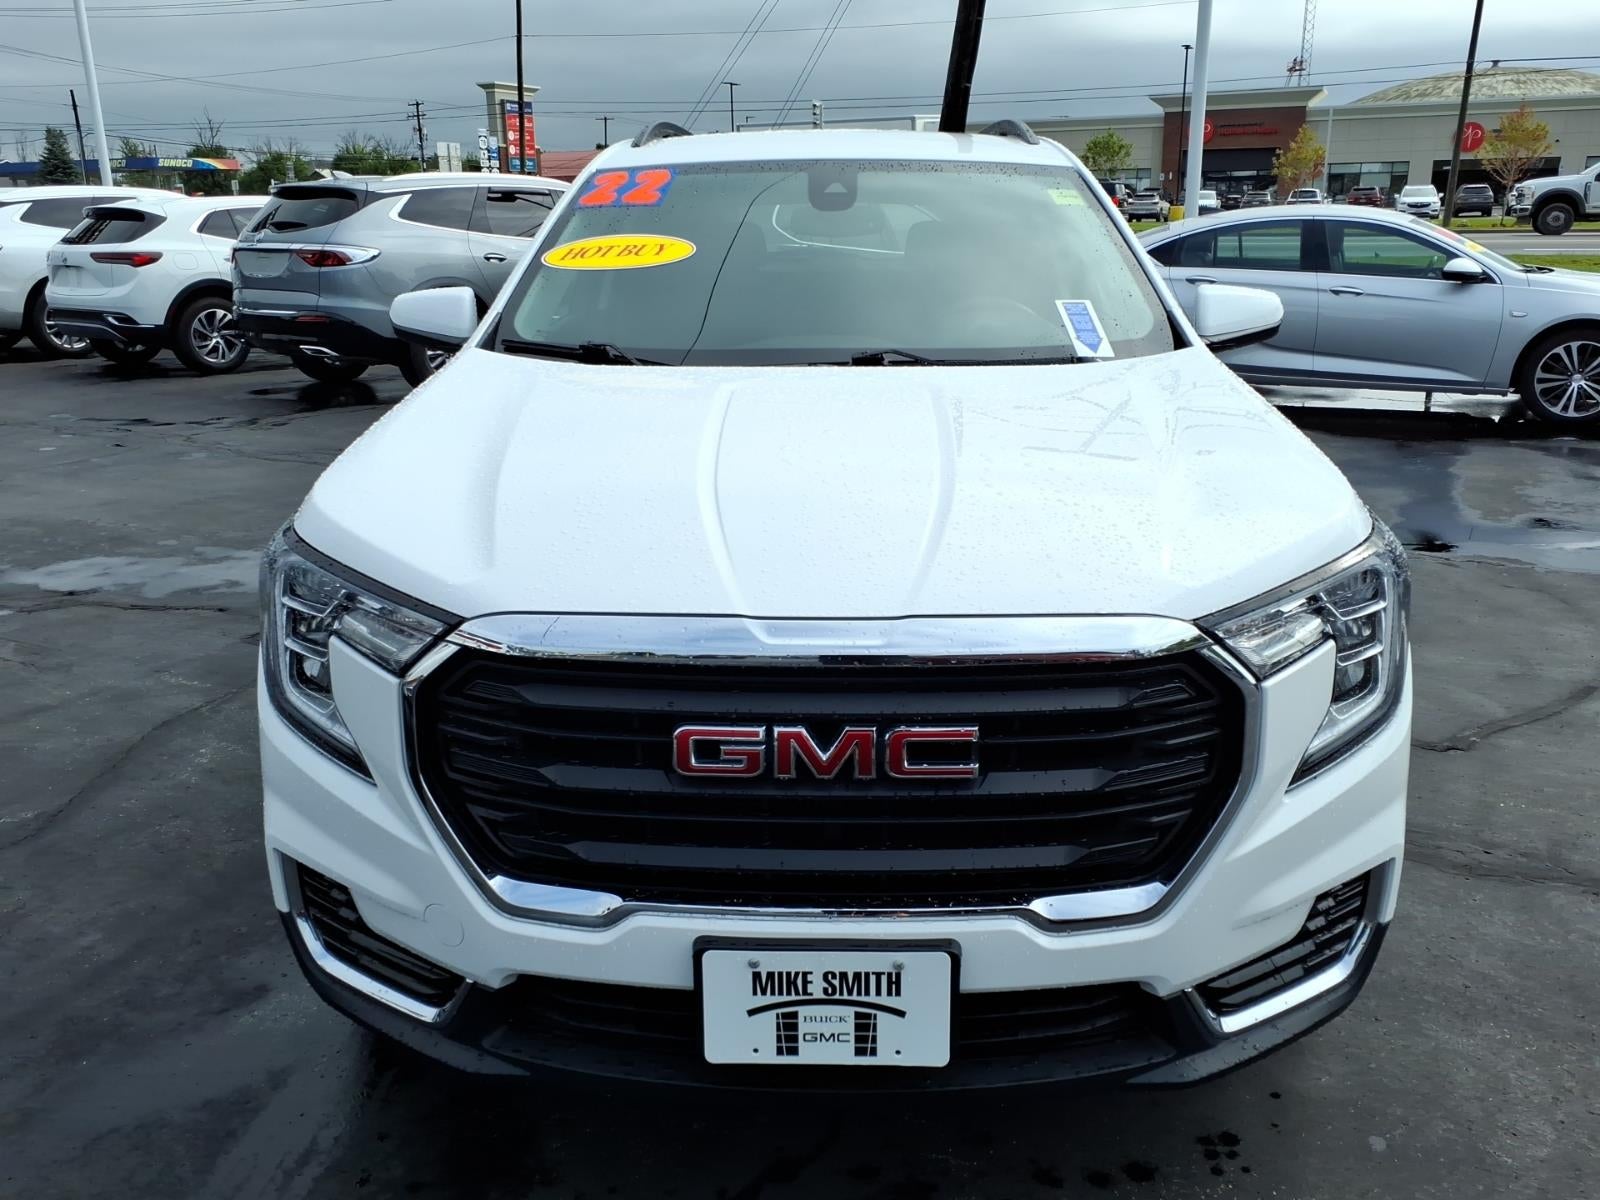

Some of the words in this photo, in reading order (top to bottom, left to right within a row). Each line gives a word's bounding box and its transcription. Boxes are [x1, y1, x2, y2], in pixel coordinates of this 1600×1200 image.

[158, 158, 193, 167] SUNOCO
[579, 169, 672, 206] 22
[560, 244, 618, 262] HOT
[617, 242, 675, 257] BUY
[672, 725, 980, 780] GMC
[751, 970, 814, 997] MIKE
[822, 970, 902, 997] SMITH
[802, 1015, 849, 1024] BUICK
[802, 1032, 851, 1043] GMC
